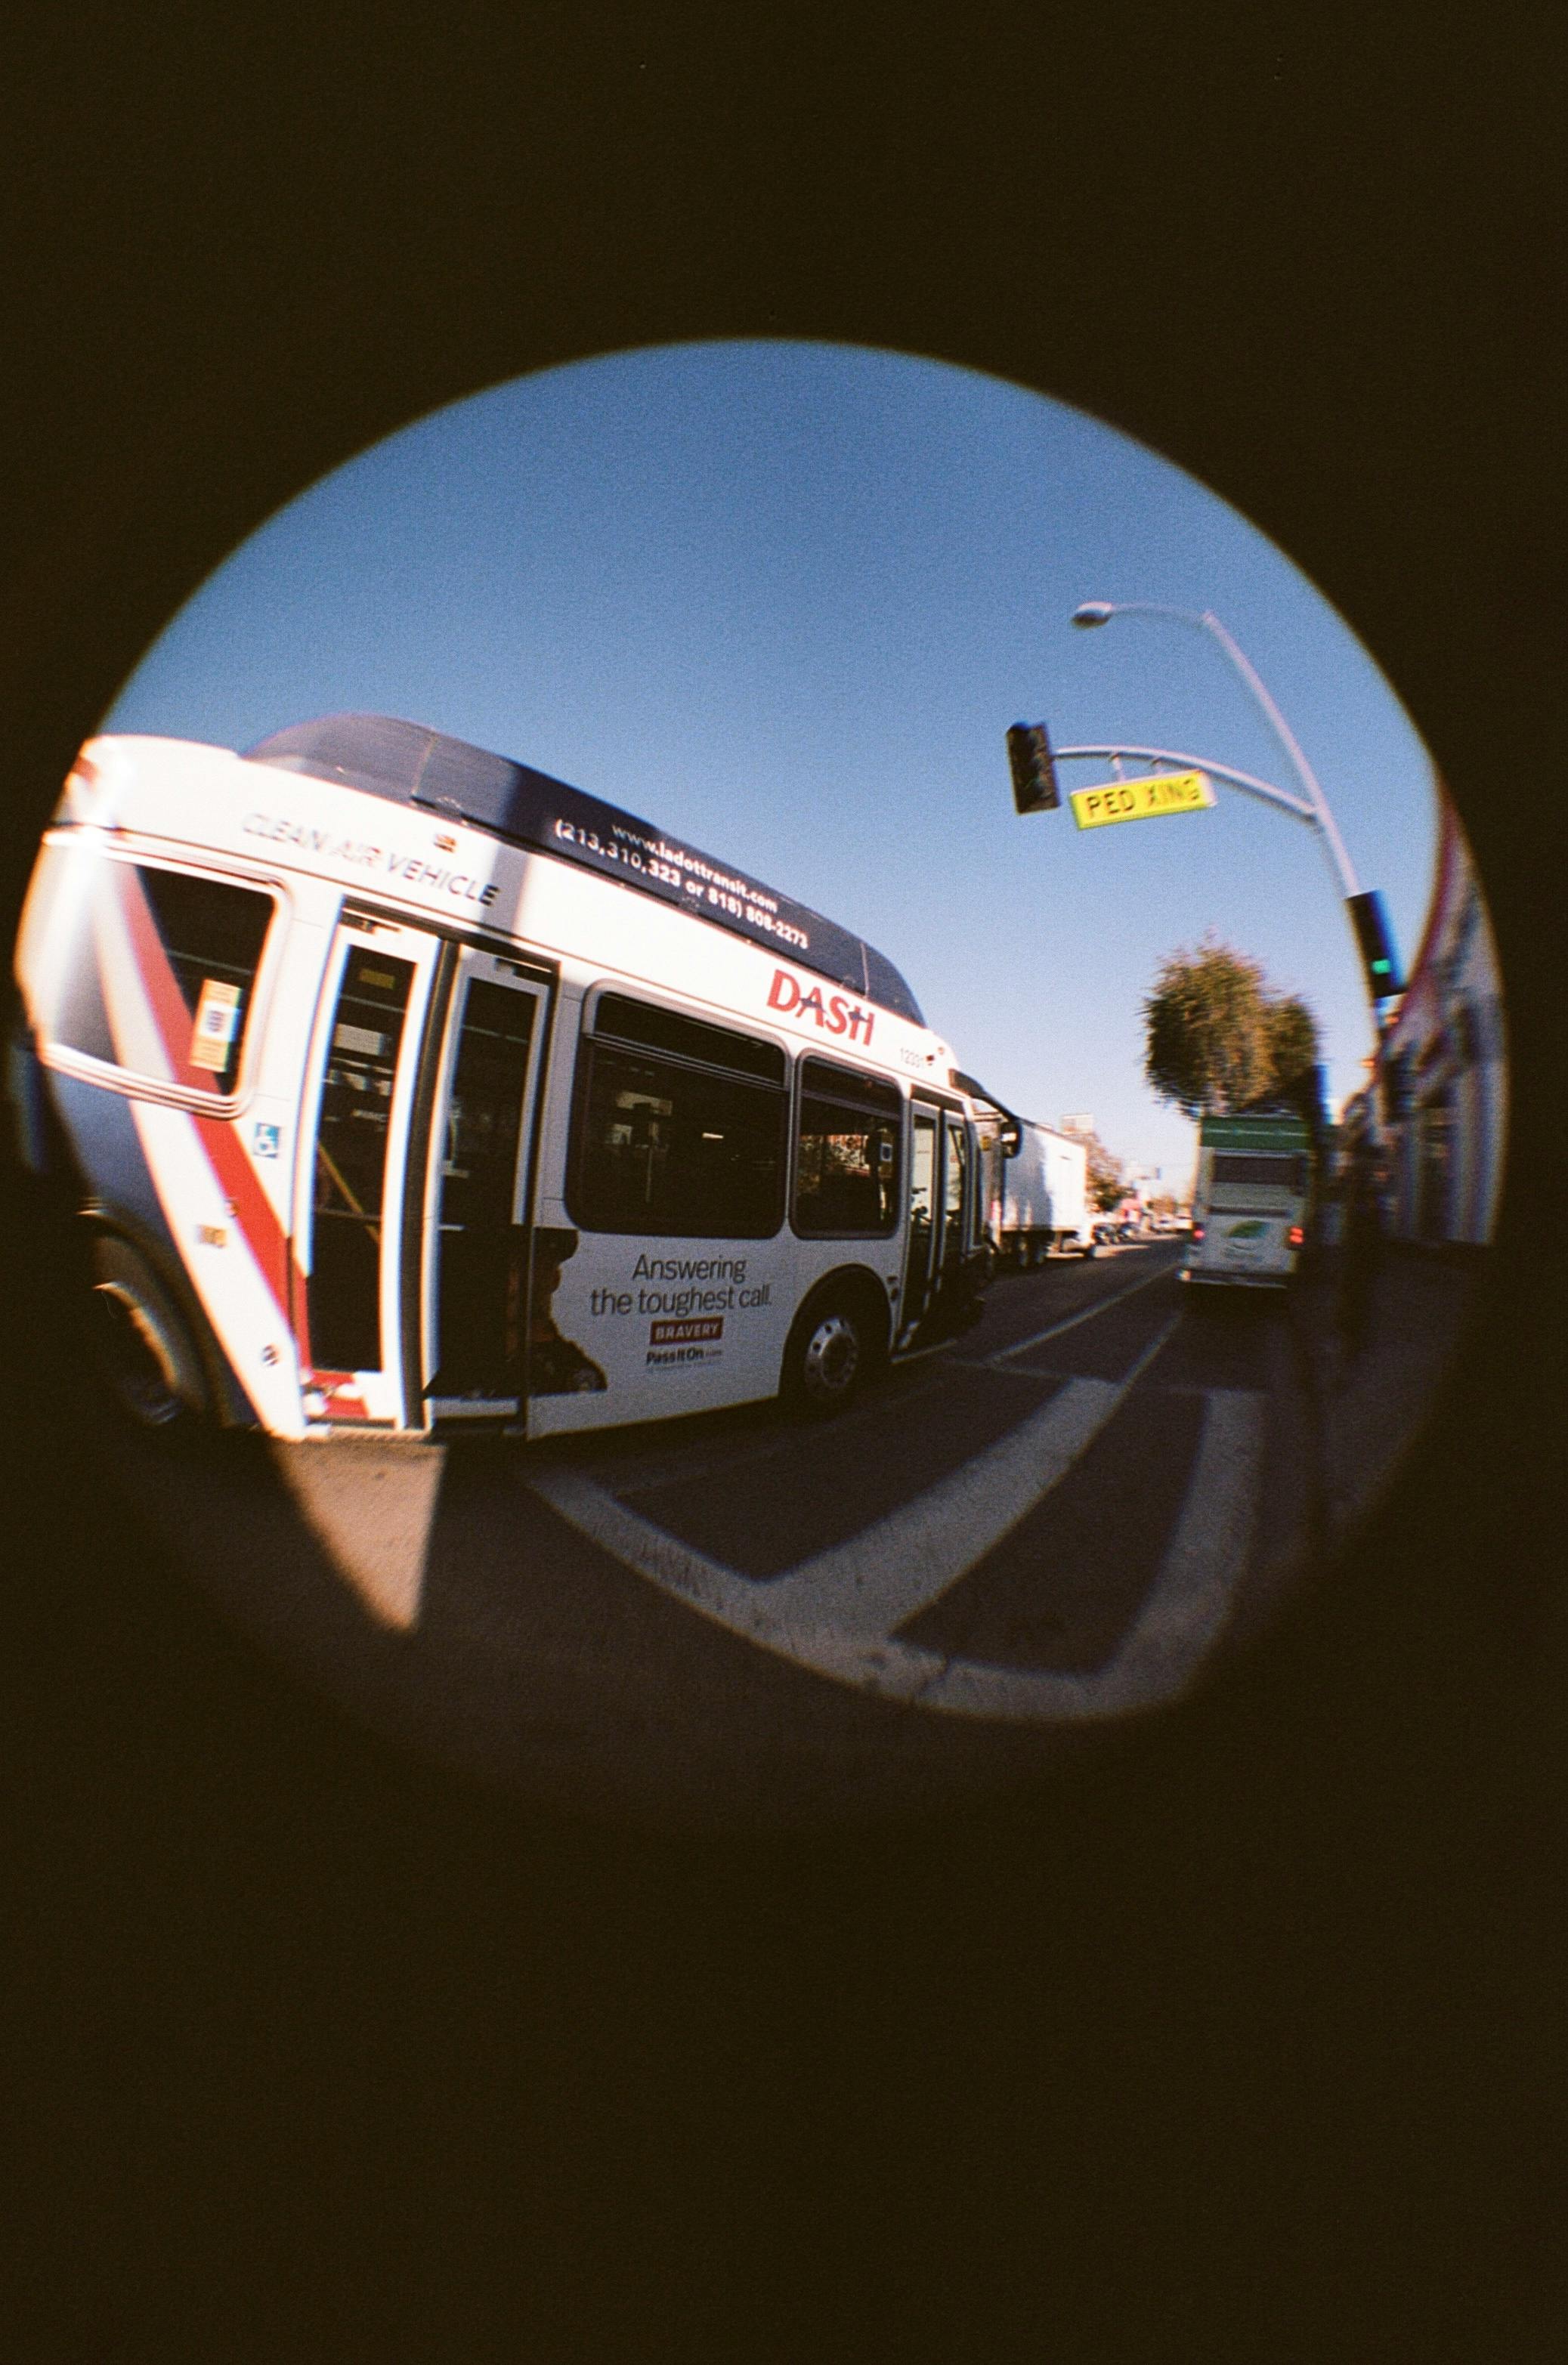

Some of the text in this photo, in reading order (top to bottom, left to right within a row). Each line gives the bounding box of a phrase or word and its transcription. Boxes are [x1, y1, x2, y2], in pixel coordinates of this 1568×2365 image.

[1087, 778, 1200, 818] PED XING
[243, 813, 500, 907] CLEAN AIR VEHICLE
[611, 824, 778, 914] www.ladottransit.com
[685, 880, 704, 898] or
[707, 886, 743, 919] 818)
[745, 905, 809, 950] 808-2273
[766, 969, 875, 1046] DASH
[632, 1254, 747, 1284] Answering
[590, 1288, 632, 1315] the
[637, 1285, 735, 1318] toughest
[654, 1323, 720, 1340] BRAVERY
